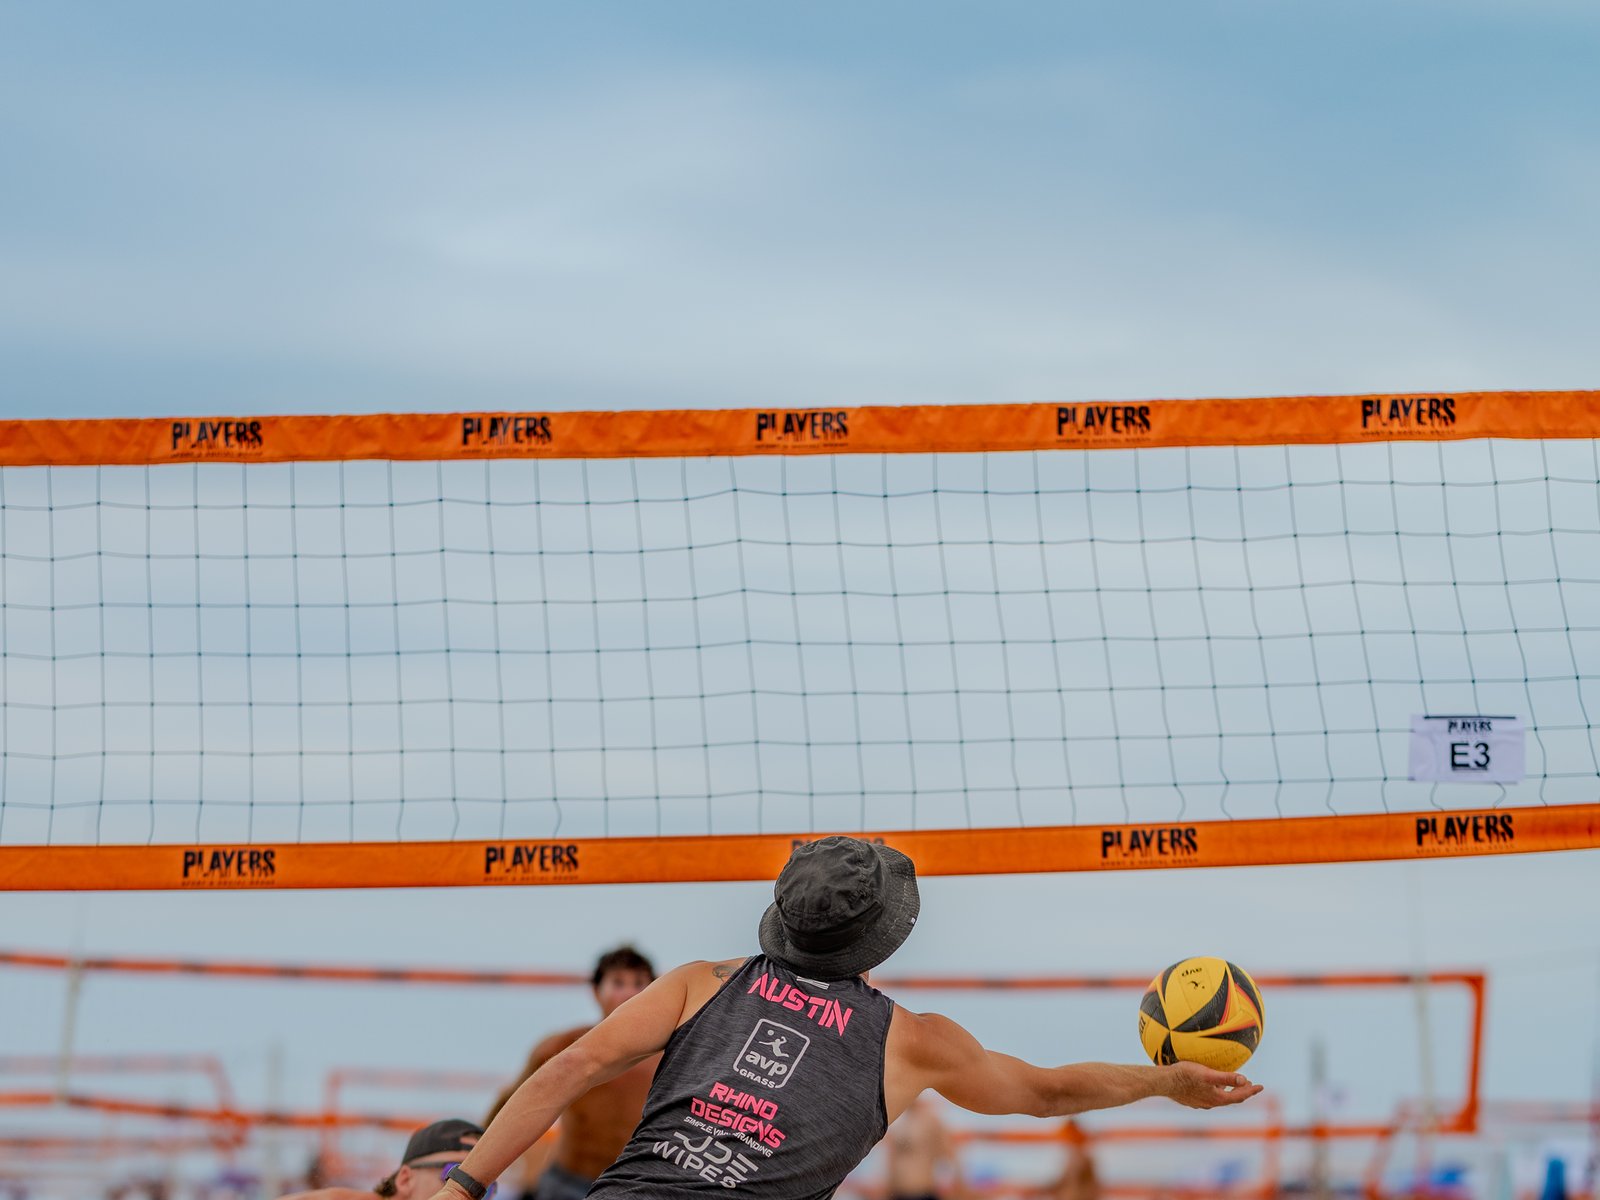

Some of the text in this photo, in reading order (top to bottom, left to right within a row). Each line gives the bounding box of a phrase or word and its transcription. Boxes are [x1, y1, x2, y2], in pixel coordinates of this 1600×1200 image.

[757, 411, 848, 441] PLAYERS
[1057, 405, 1150, 436] PLAYERS
[1362, 398, 1456, 428] PLAYERS
[172, 421, 263, 450] PLAYERS
[463, 416, 552, 445] PLAYERS
[1451, 742, 1491, 768] E3
[1102, 827, 1198, 858] PLAYERS
[1416, 814, 1514, 846] PLAYERS
[183, 849, 275, 878] PLAYERS
[485, 844, 578, 874] PLAYERS
[747, 972, 853, 1037] AUSTIN
[739, 1068, 776, 1089] GRASS
[745, 1050, 788, 1077] avp
[709, 1081, 779, 1121] RHINO
[690, 1097, 786, 1149] DESIGNS
[652, 1141, 741, 1189] WIPES
